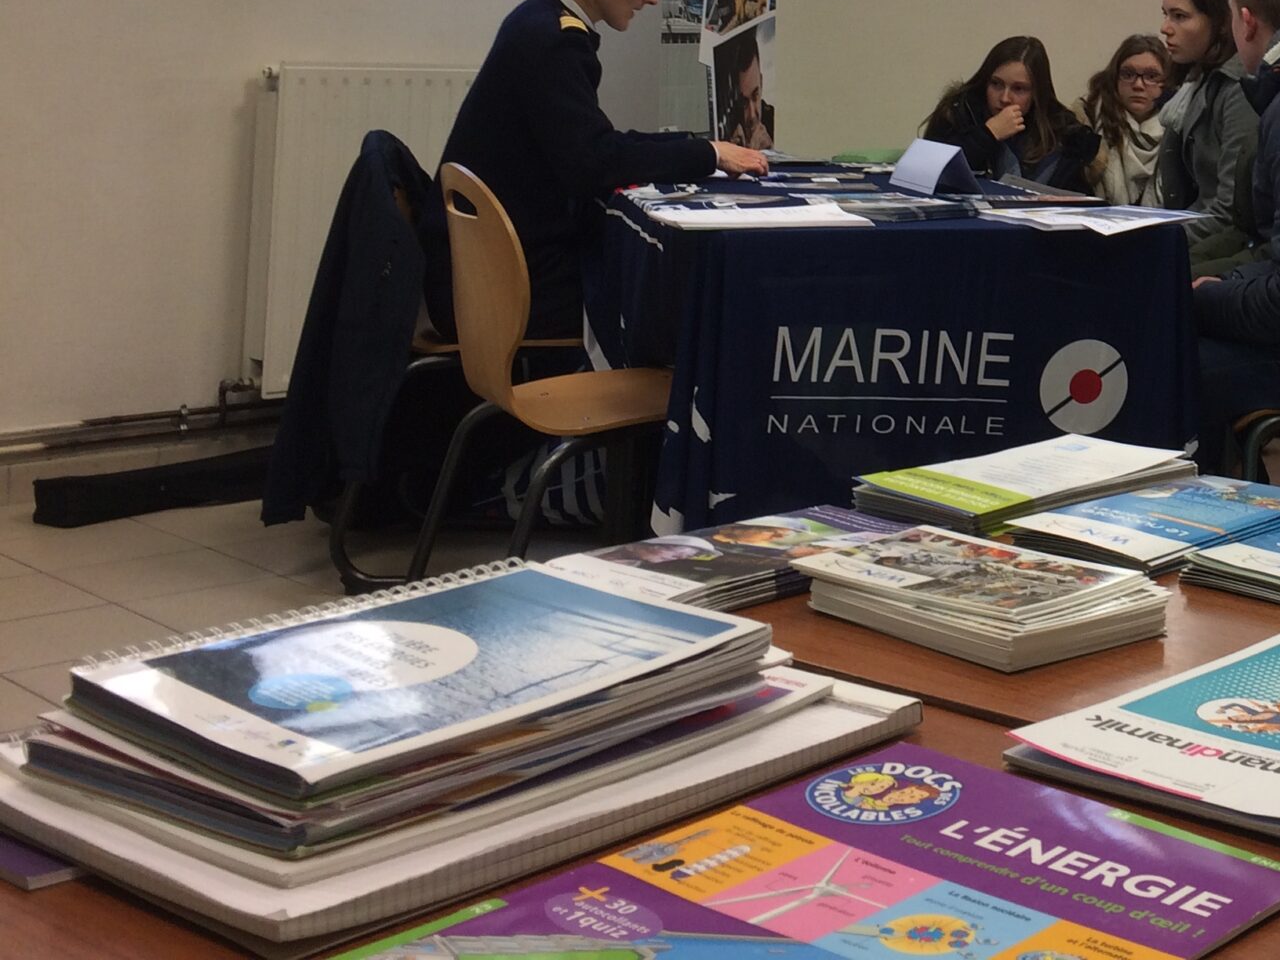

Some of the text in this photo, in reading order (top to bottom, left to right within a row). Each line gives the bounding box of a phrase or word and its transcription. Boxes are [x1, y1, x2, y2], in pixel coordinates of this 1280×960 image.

[772, 325, 1015, 387] MARINE
[767, 413, 1006, 436] NATIONALE
[881, 762, 963, 792] DOCS
[813, 778, 923, 822] INCOLLABLES
[900, 833, 933, 849] Tout
[933, 845, 1020, 878] comprendre
[1021, 871, 1068, 897] d'un
[1072, 889, 1126, 915] coup
[938, 819, 1233, 918] L'ÉNERGIE
[574, 900, 651, 935] autocollants
[605, 897, 638, 915] 30
